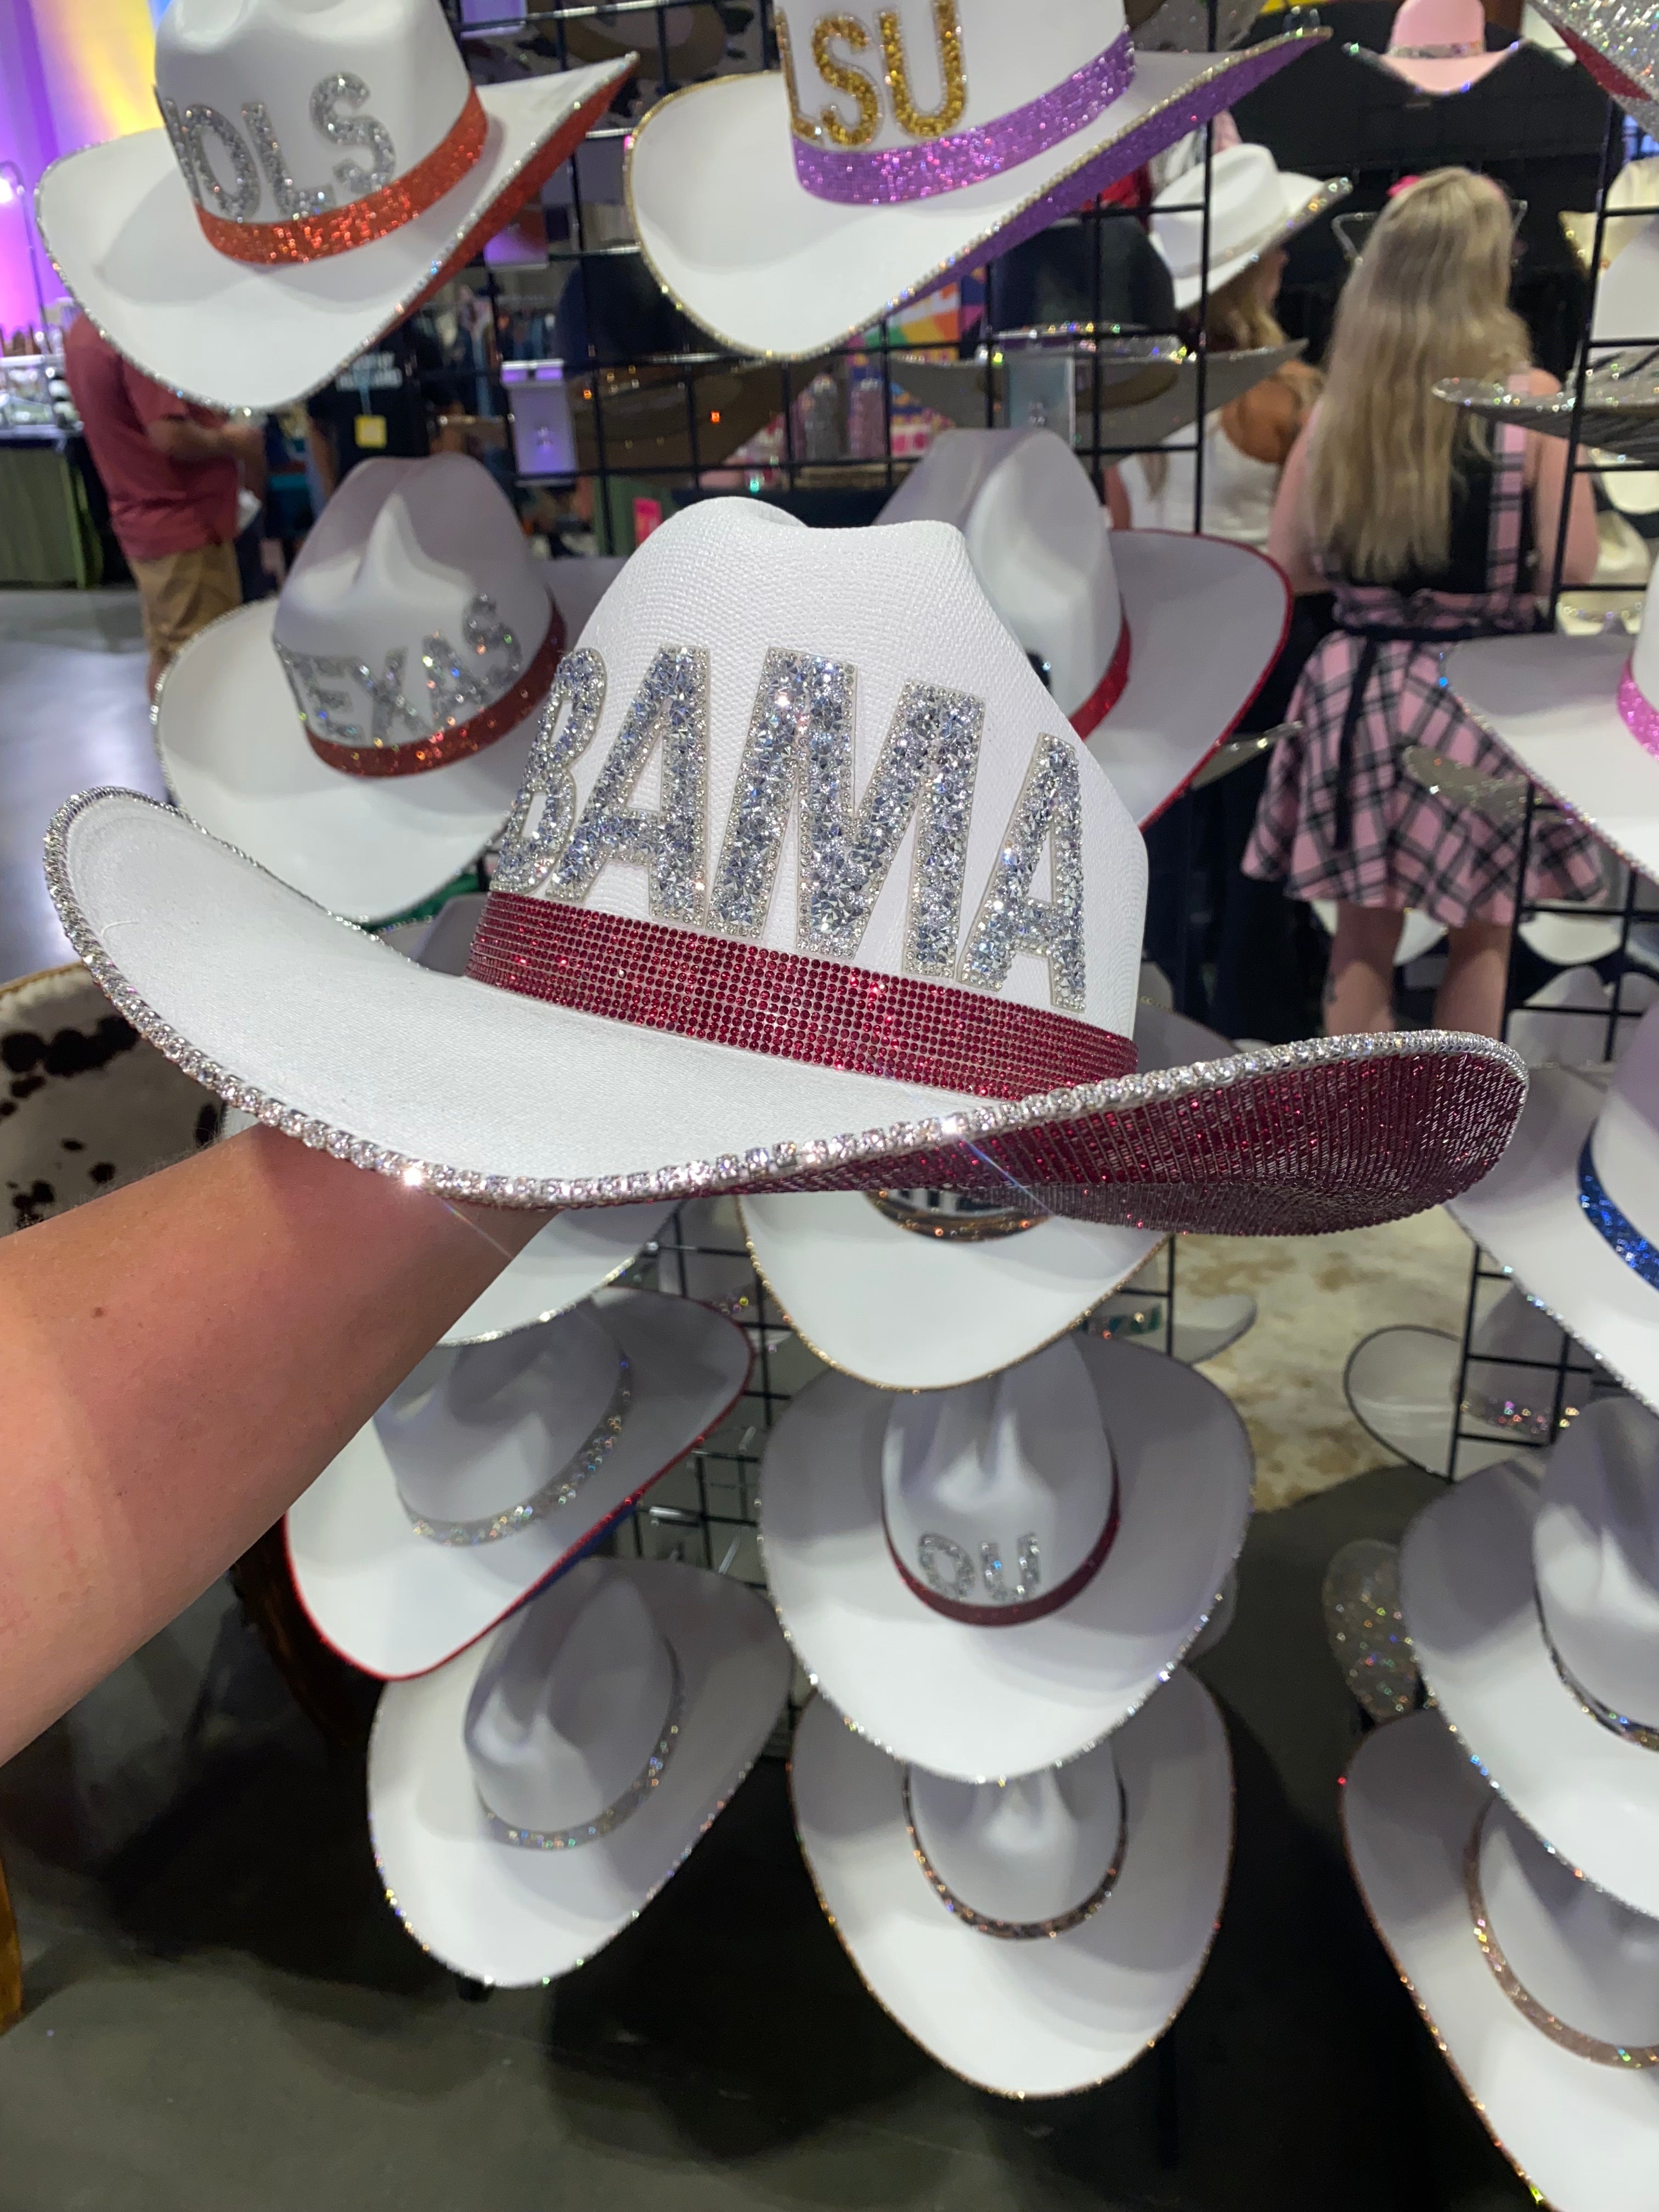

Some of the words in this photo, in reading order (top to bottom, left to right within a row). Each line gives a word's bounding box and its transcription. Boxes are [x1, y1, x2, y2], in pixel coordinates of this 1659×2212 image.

[272, 594, 521, 738] EXAS
[489, 643, 1087, 1012] BAMA
[918, 1532, 1041, 1603] OU
